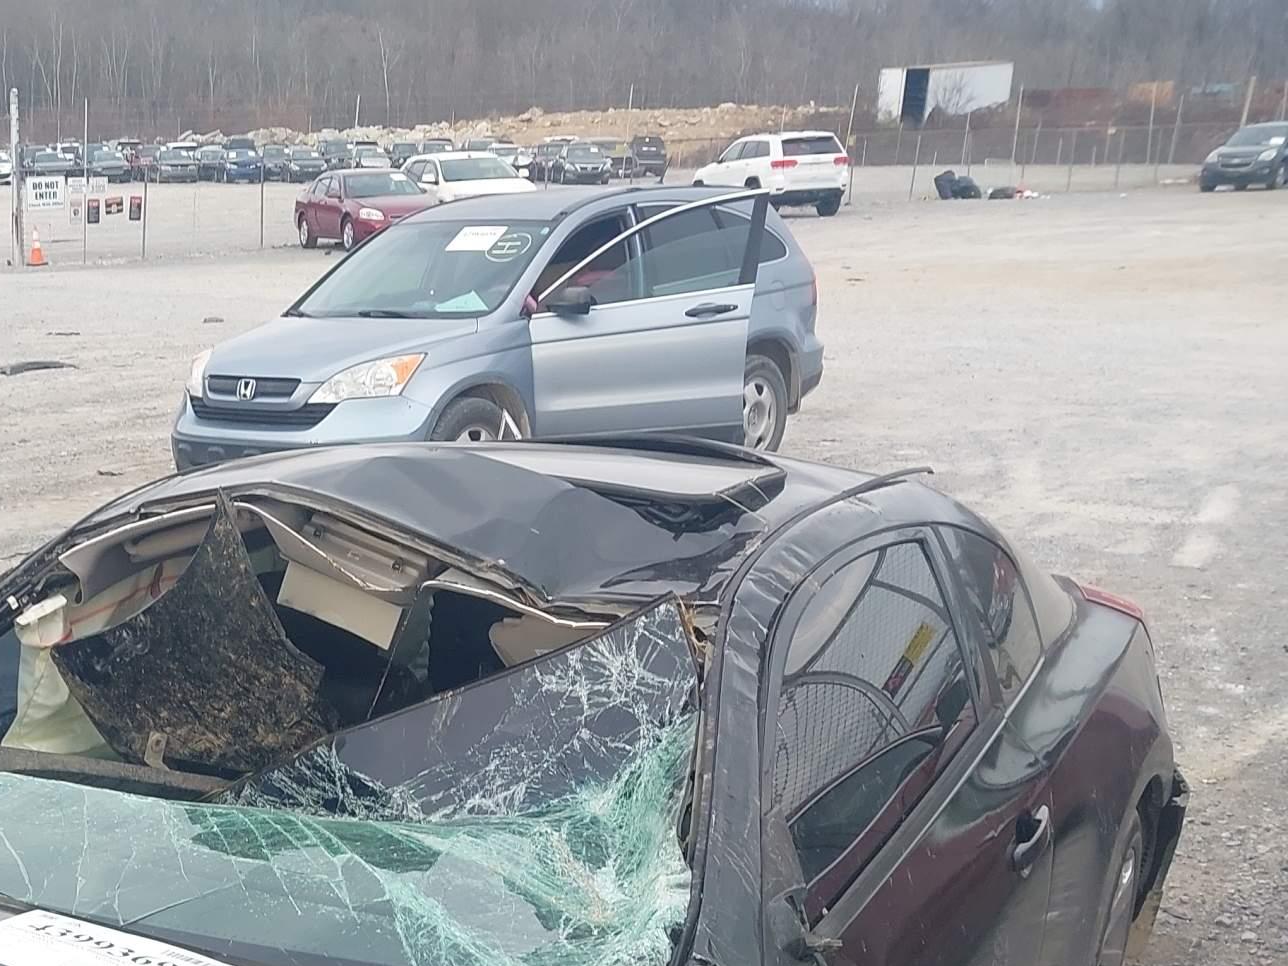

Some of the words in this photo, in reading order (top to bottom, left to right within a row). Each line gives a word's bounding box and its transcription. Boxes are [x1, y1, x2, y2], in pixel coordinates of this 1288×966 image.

[32, 181, 43, 190] DO
[45, 180, 59, 190] NOT
[35, 191, 58, 200] ENTER
